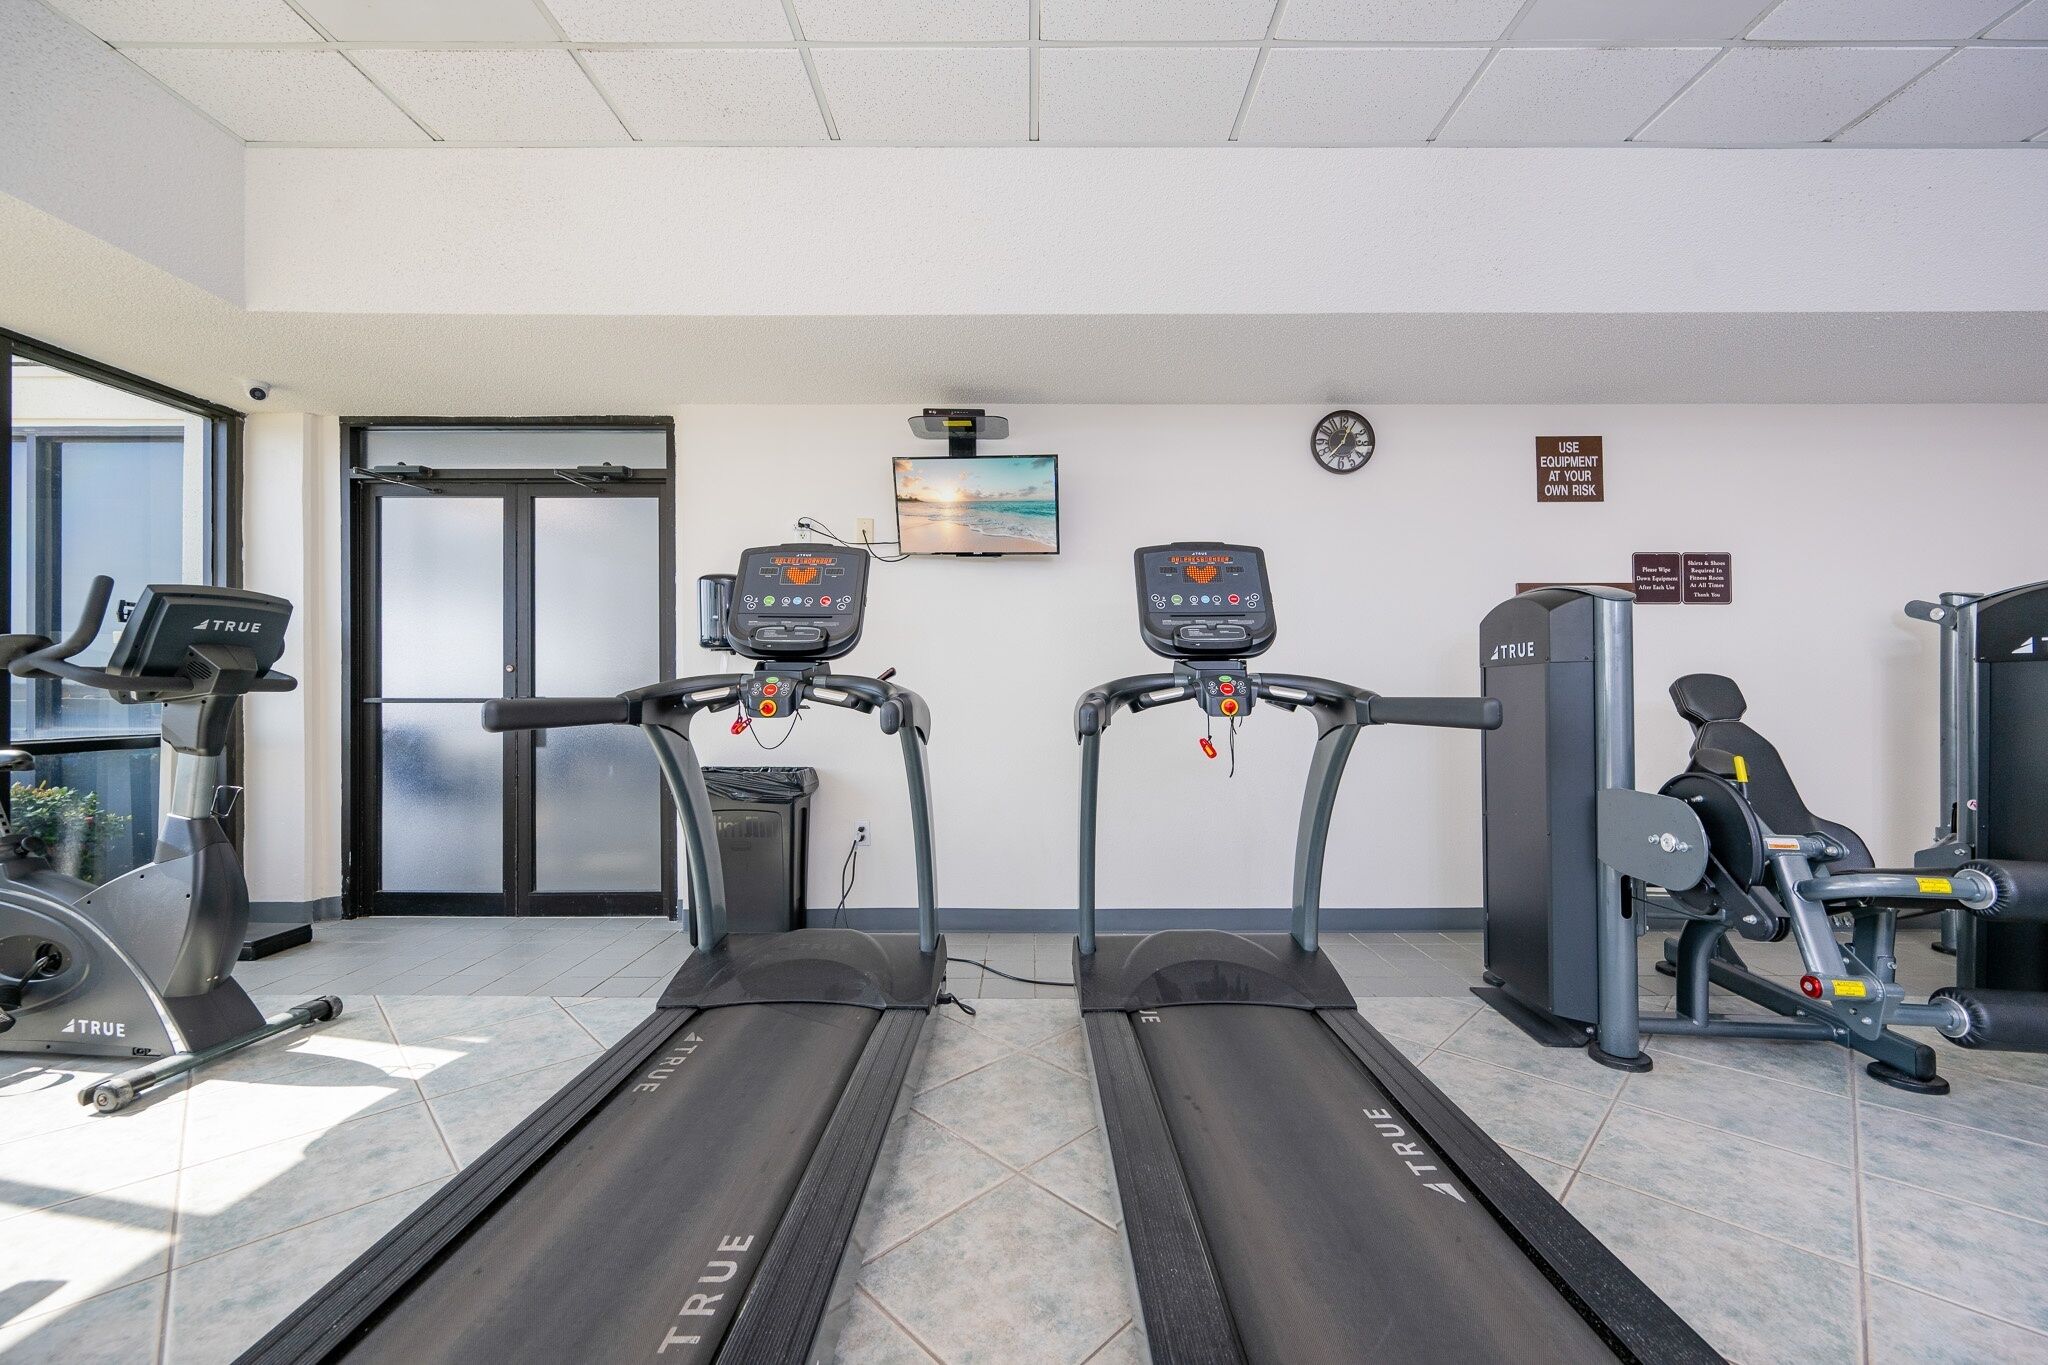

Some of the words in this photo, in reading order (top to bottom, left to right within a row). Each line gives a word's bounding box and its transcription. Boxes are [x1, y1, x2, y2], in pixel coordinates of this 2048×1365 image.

[1558, 441, 1580, 453] USE
[1540, 455, 1599, 468] EQUIPMENT
[1548, 470, 1561, 482] AT
[1563, 470, 1592, 482] YOUR
[1544, 484, 1569, 497] OWN
[1572, 484, 1597, 496] RISK
[213, 619, 262, 633] TRUE
[1500, 641, 1535, 659] TRUE
[77, 1019, 126, 1038] TRUE
[632, 1045, 698, 1092] TRUE
[1362, 1108, 1438, 1176] TRUE
[657, 1234, 755, 1354] TRUE
